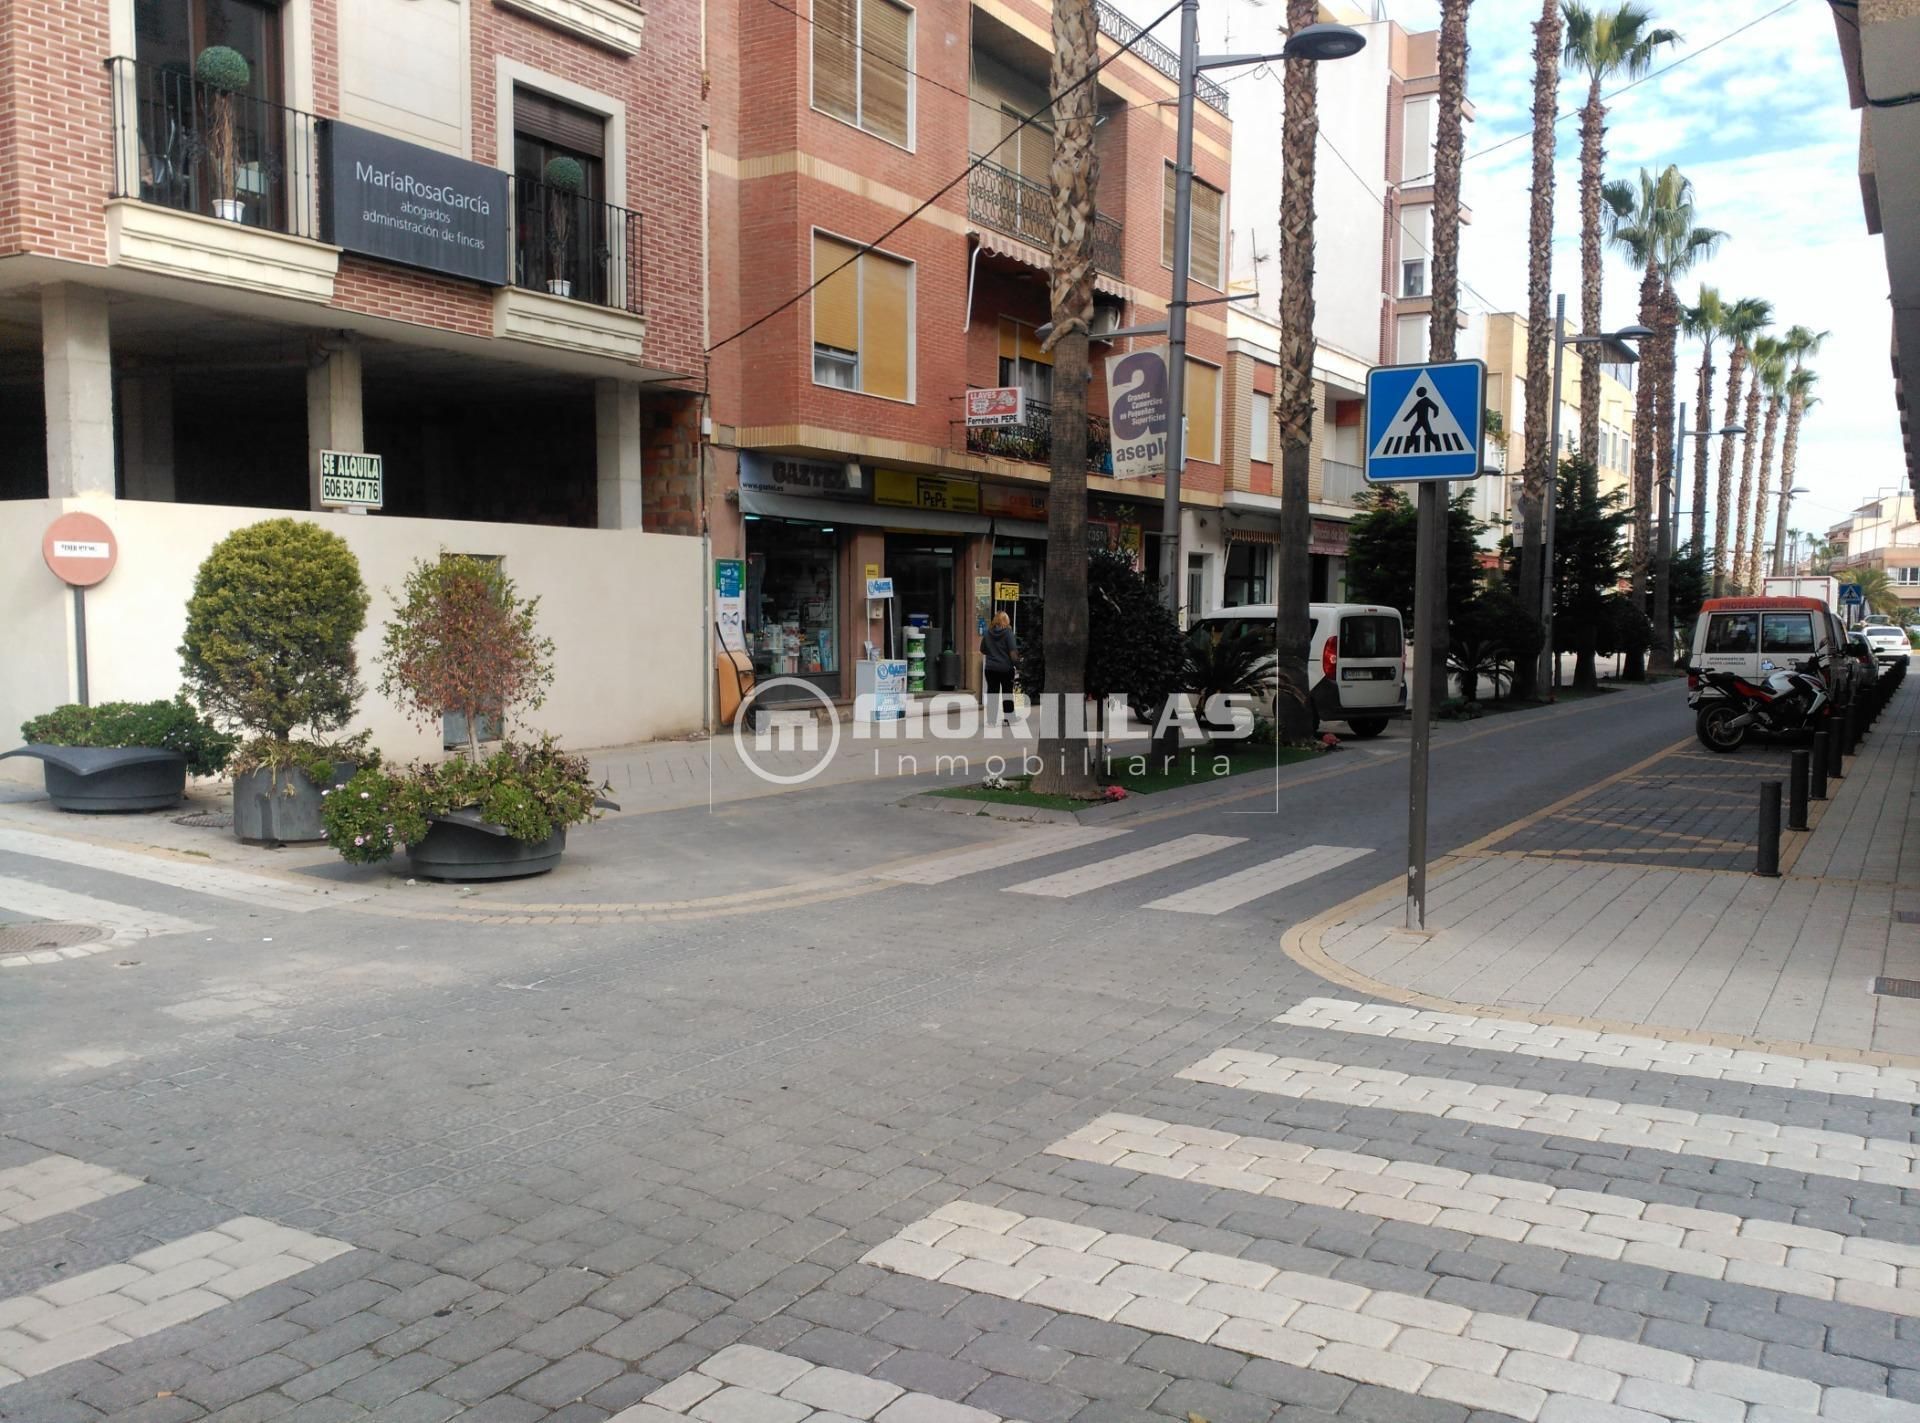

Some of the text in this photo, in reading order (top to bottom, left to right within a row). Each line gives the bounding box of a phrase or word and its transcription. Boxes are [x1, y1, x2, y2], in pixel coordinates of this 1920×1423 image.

[400, 200, 451, 224] abogados
[362, 209, 485, 249] administración de fincas
[970, 391, 997, 400] LLAVES
[1127, 391, 1151, 403] Grandes
[1001, 414, 1018, 423] PEPE
[1116, 437, 1168, 462] asepl
[323, 454, 379, 479] SE ALQUILA
[324, 478, 379, 500] 606 53 47 76
